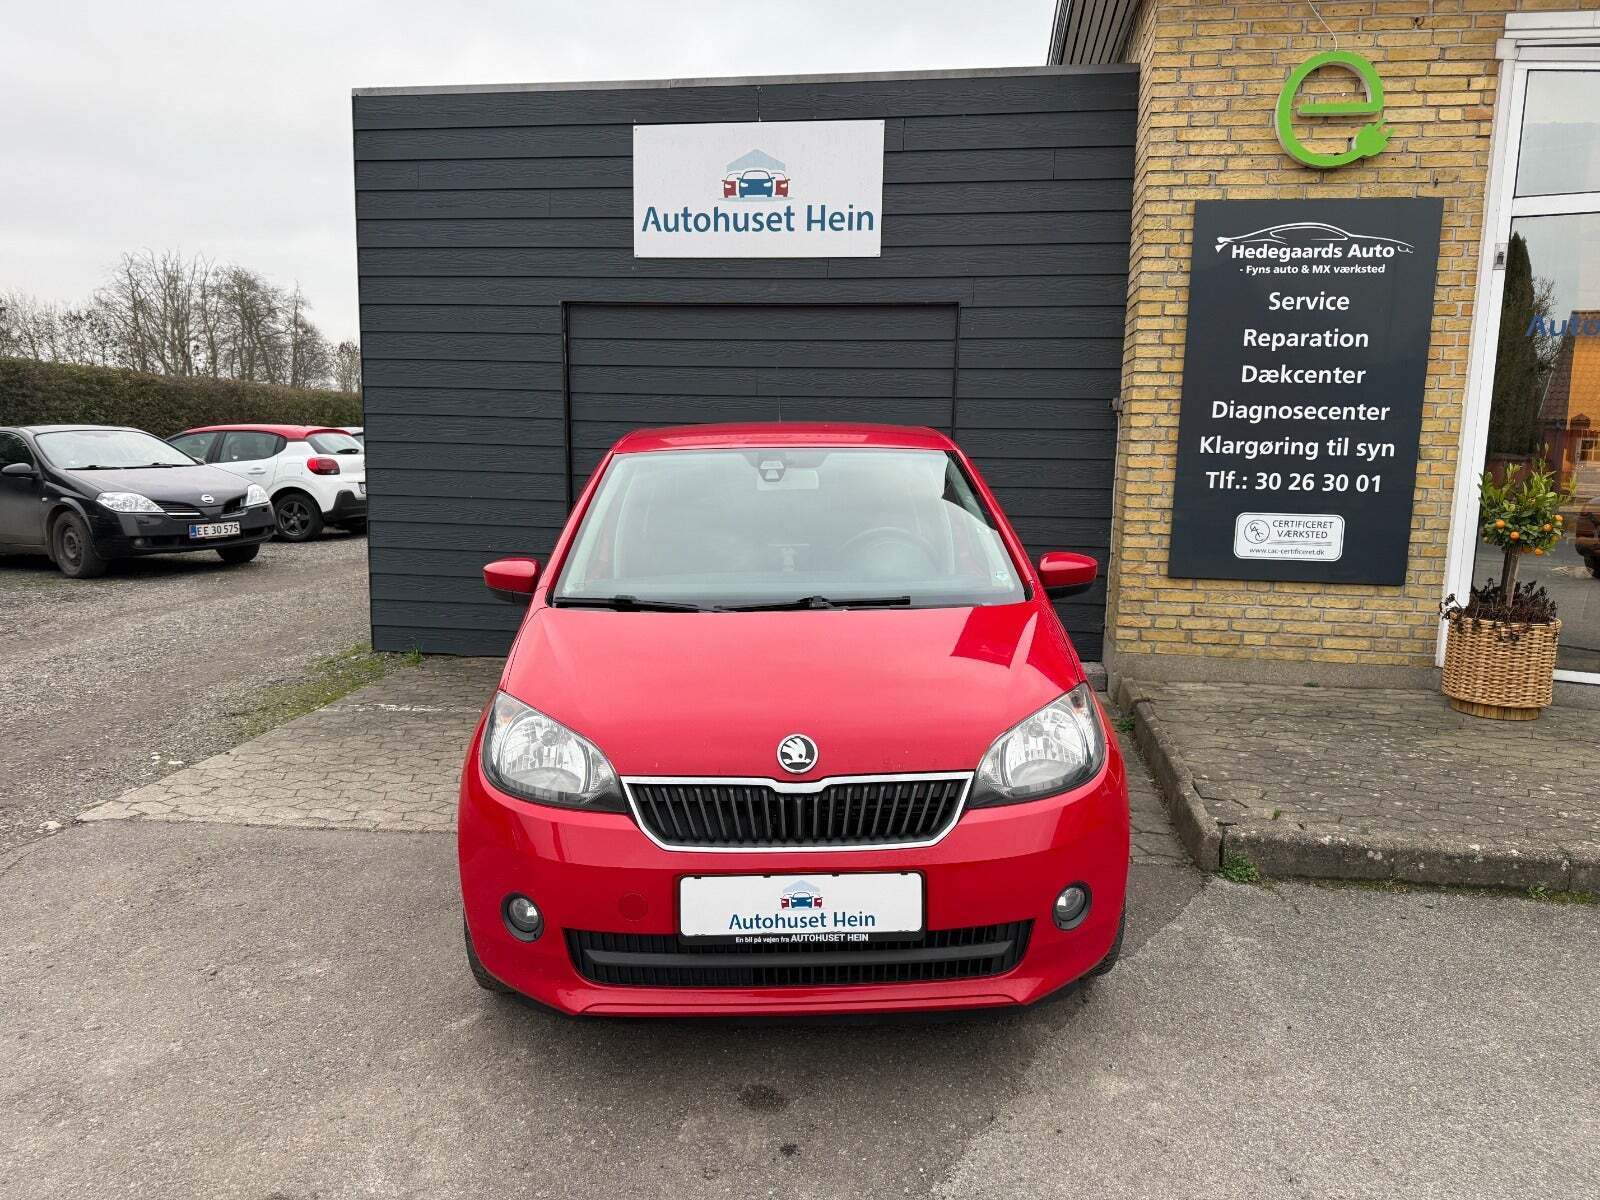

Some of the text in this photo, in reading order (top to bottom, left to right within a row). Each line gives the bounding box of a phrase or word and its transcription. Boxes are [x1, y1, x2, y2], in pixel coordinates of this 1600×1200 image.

[642, 204, 874, 232] Autohuset Hein
[1231, 243, 1395, 262] Hedegaards Auto
[1246, 265, 1271, 276] Fyns
[1273, 265, 1299, 274] auto
[1301, 264, 1309, 274] &
[1312, 265, 1331, 274] MX
[1333, 264, 1386, 274] værksted
[1268, 291, 1350, 311] Service
[1243, 328, 1369, 352] Reparation
[1241, 364, 1366, 385] Dækcenter
[1211, 400, 1391, 424] Diagnosecenter
[1199, 435, 1396, 462] Klargøring til syn
[1206, 470, 1382, 493] Tlf.: 30 26 30 01
[197, 523, 239, 536] EE 30 575
[1272, 519, 1335, 529] CERTIFICERET
[1276, 530, 1328, 539] VÆRKSTED
[728, 911, 876, 930] Autohuset Hein
[762, 936, 780, 944] vejen
[790, 933, 846, 942] AUTOHUSET
[847, 933, 869, 942] HEIN
